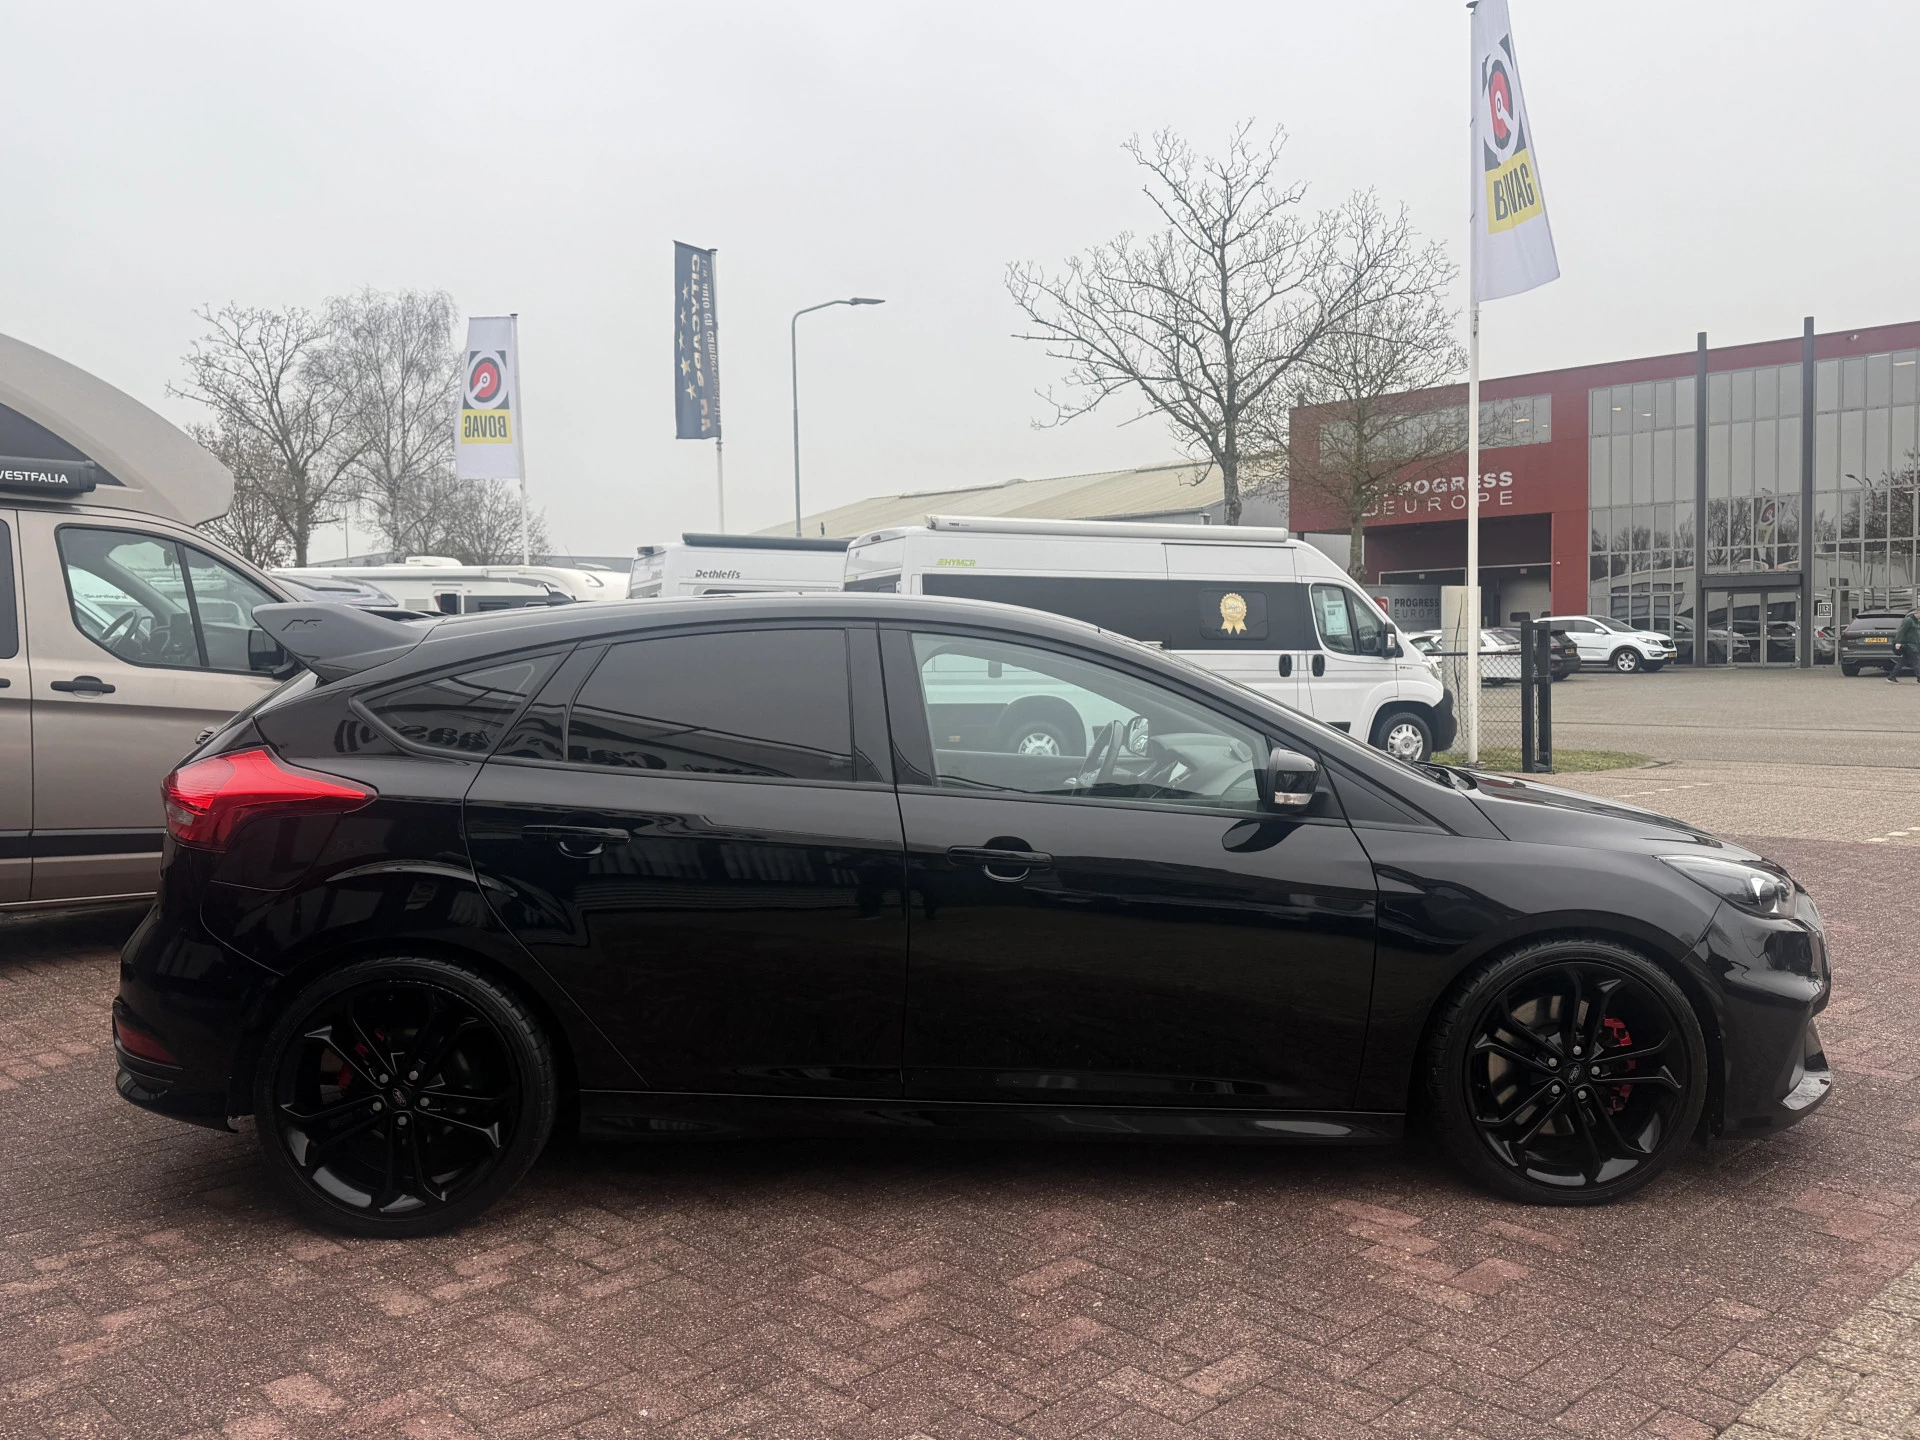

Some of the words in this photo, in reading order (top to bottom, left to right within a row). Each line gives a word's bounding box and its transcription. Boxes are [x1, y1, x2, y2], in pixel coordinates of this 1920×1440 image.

[944, 558, 976, 567] HYMER
[695, 569, 741, 579] Dethleffs
[1394, 598, 1440, 608] PROGRESS
[1394, 609, 1440, 619] EUROPE
